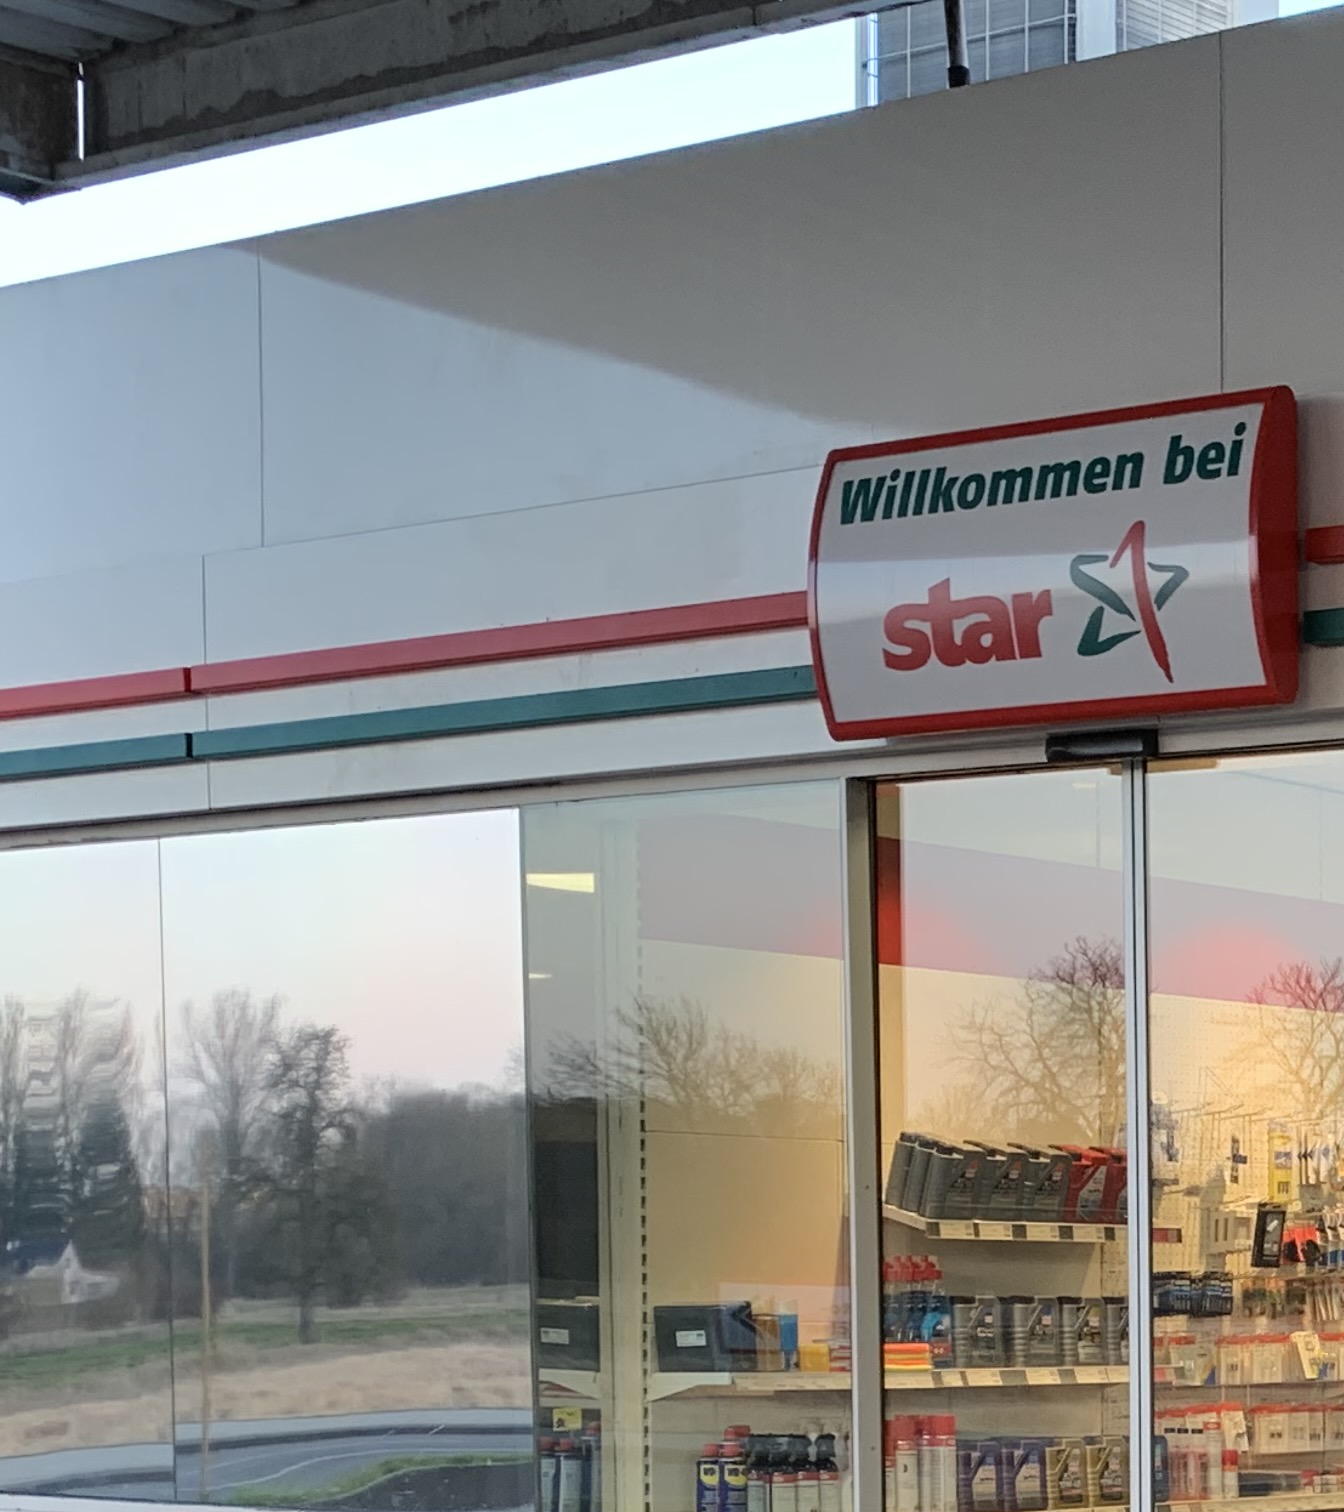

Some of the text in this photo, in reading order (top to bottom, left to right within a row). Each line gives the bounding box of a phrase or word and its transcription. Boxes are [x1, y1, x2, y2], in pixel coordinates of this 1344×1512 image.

[840, 422, 1247, 526] Willkommen bei
[881, 577, 1053, 672] star
